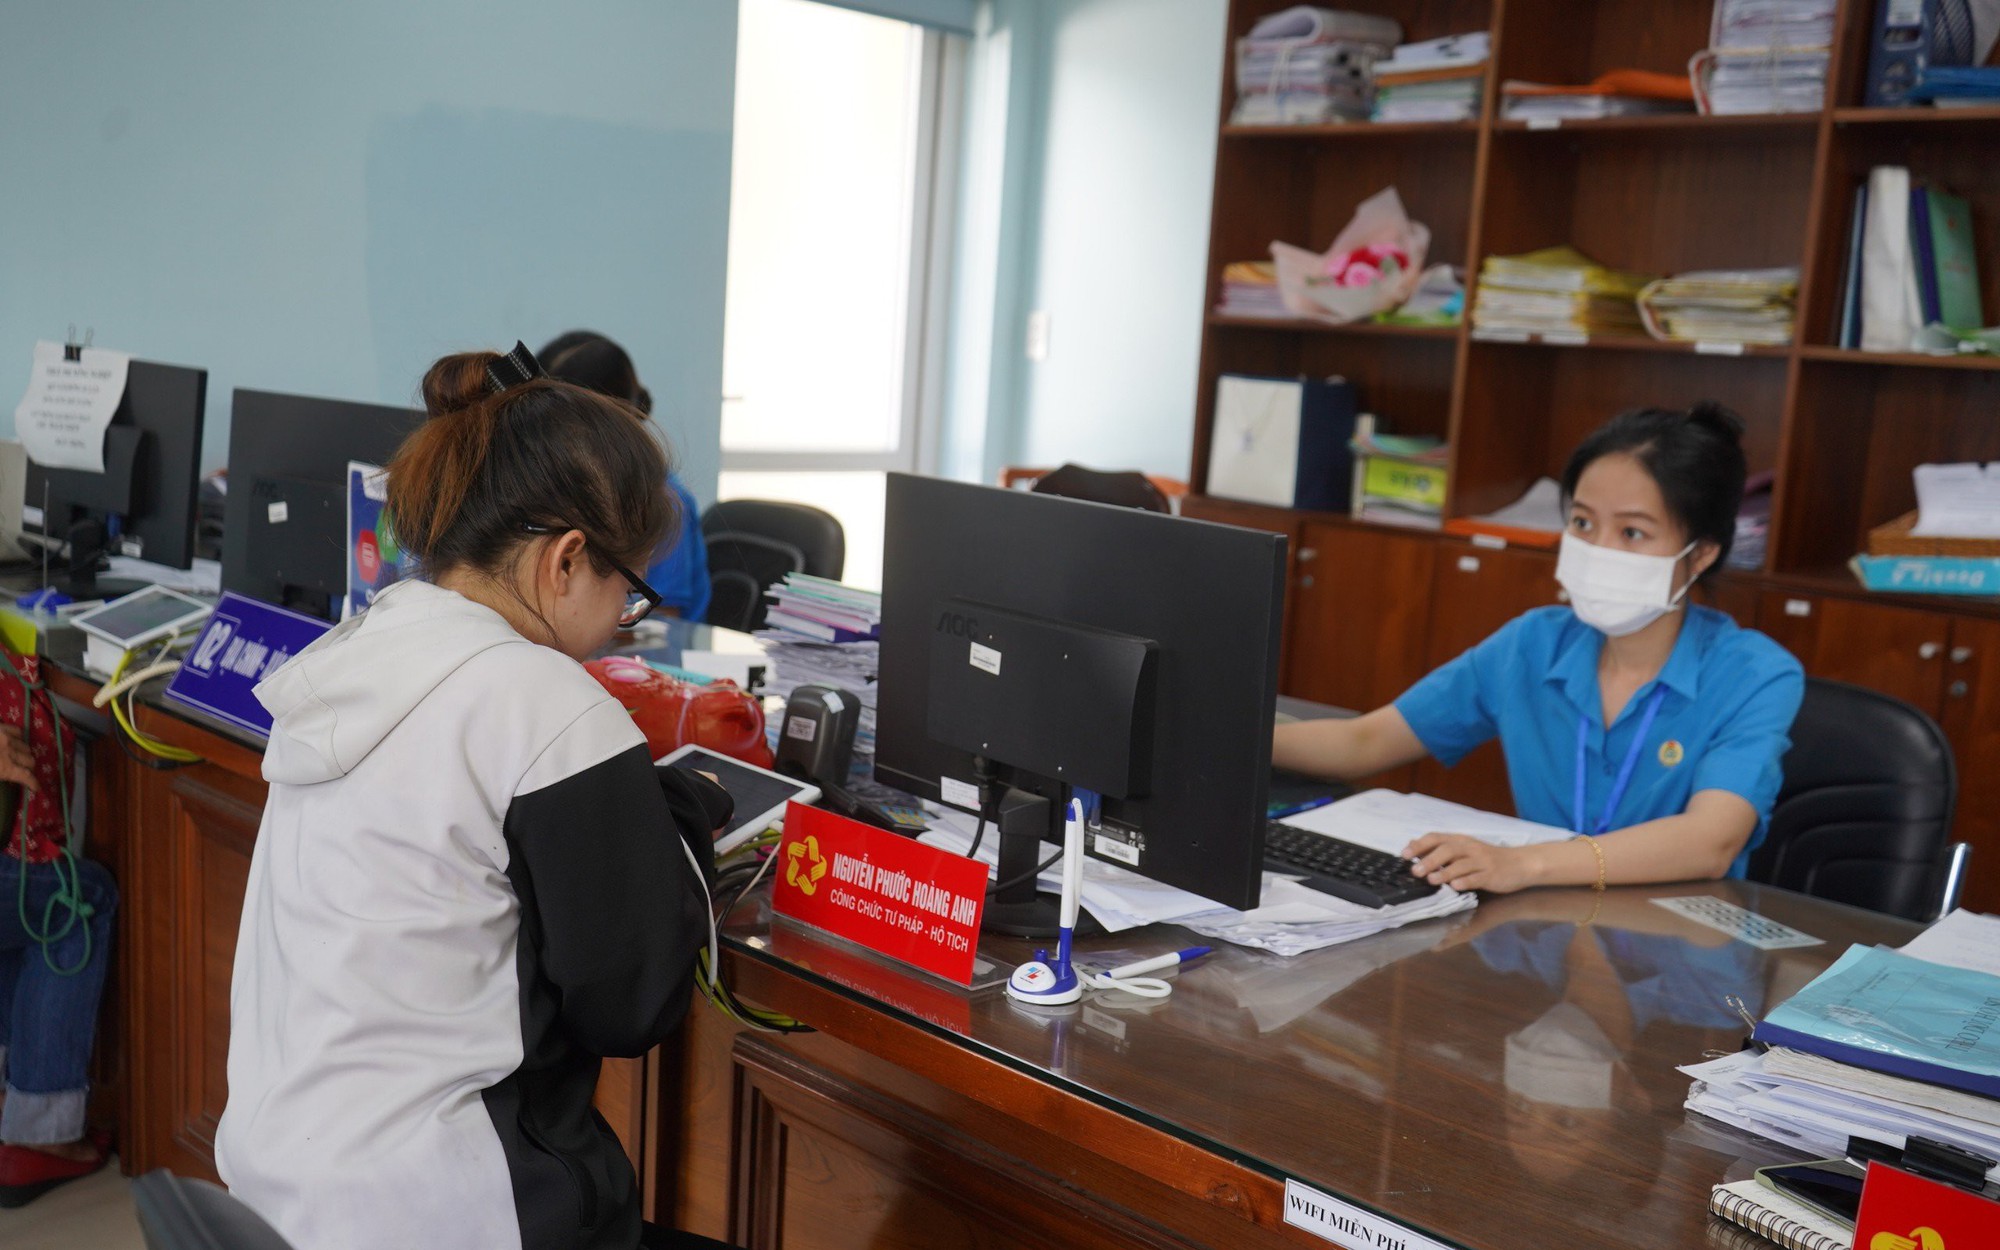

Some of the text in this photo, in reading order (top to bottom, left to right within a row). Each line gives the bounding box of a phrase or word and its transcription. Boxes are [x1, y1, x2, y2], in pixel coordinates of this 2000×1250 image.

[193, 621, 232, 669] 02
[936, 611, 978, 641] AOC
[832, 853, 977, 928] NGUYỄN PHƯỚC HOÀNG ANH
[830, 888, 856, 911] CÔNG
[857, 899, 882, 921] CHỨC
[885, 909, 898, 926] TƯ
[898, 914, 923, 938] PHÁP
[930, 924, 945, 946] HỘ
[947, 931, 969, 953] TỊCH
[1289, 1194, 1325, 1222] WIFI
